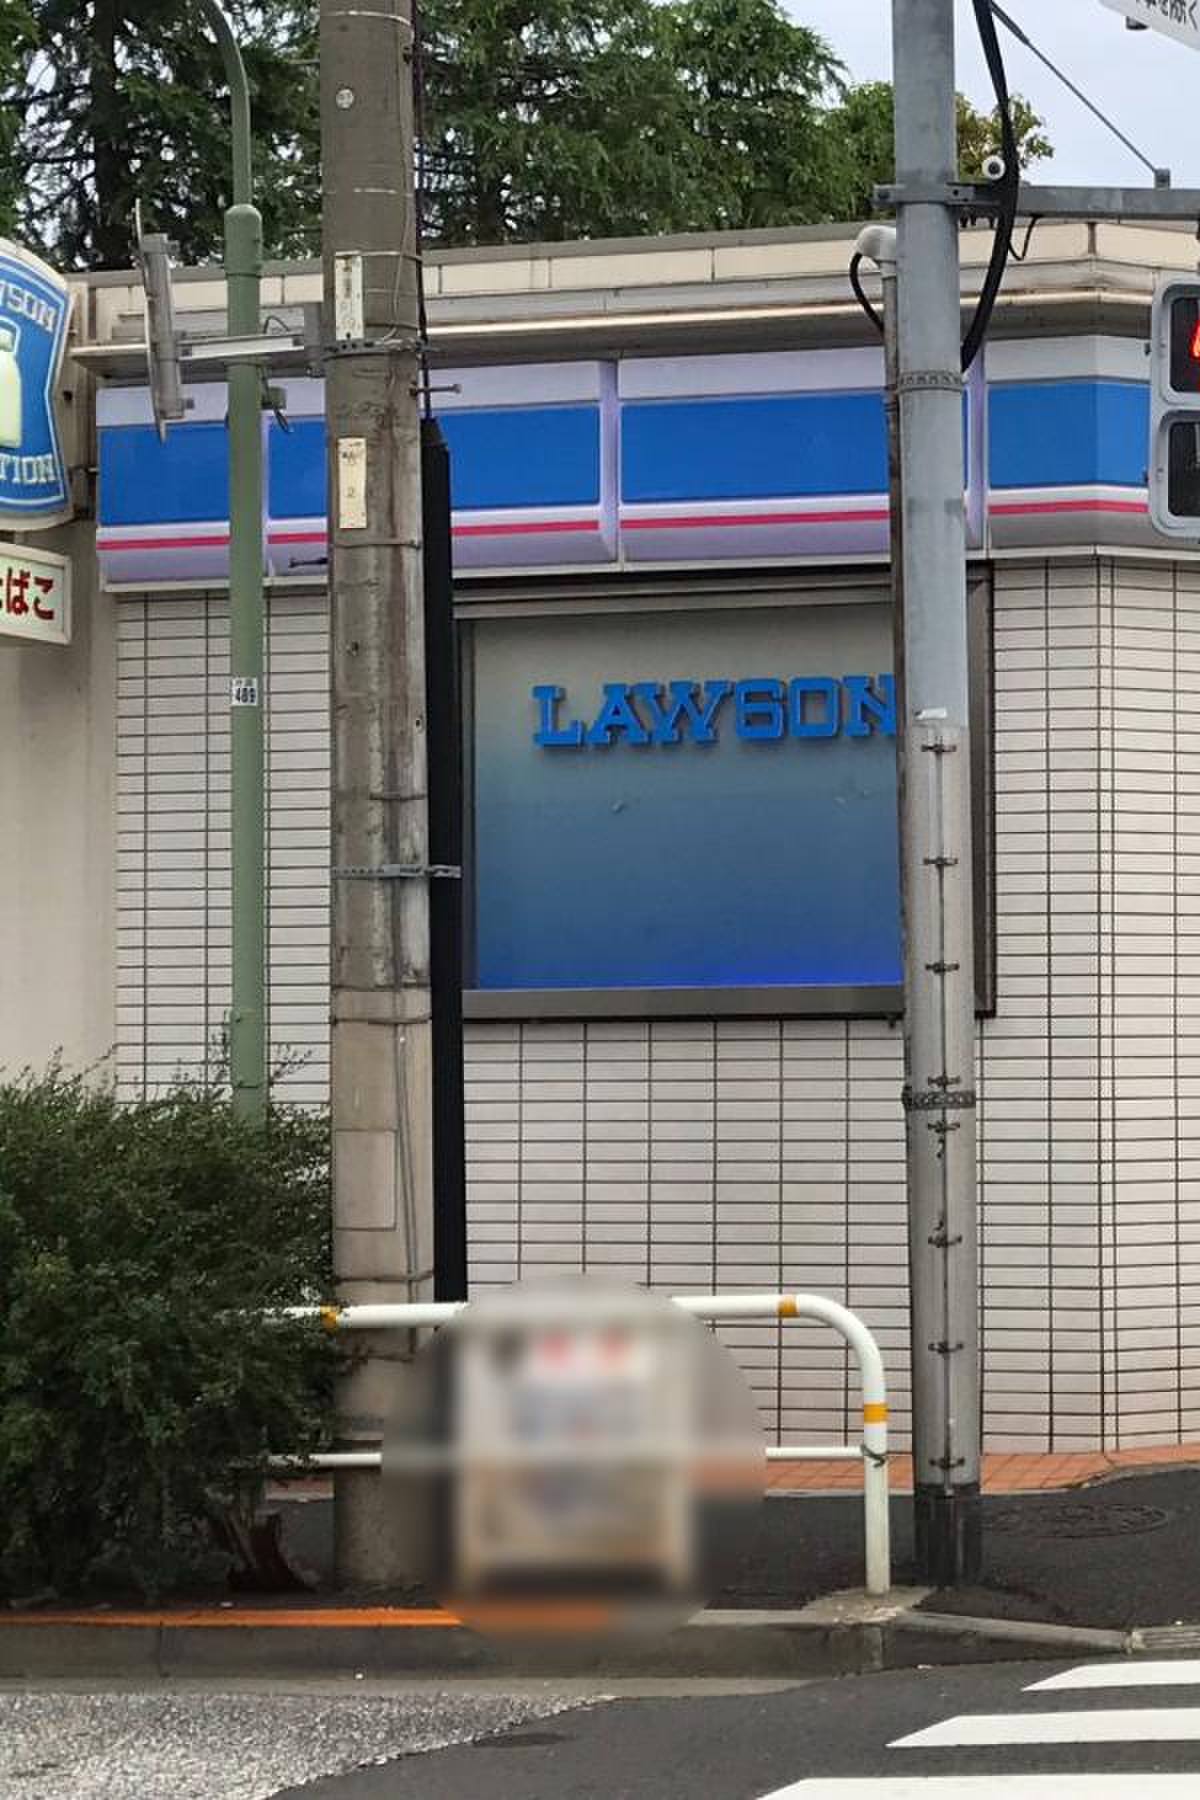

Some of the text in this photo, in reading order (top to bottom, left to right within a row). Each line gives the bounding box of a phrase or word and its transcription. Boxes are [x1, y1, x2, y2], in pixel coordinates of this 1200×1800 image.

[0, 280, 56, 332] SON
[0, 567, 54, 620] ばこ
[532, 672, 897, 747] LAWSON
